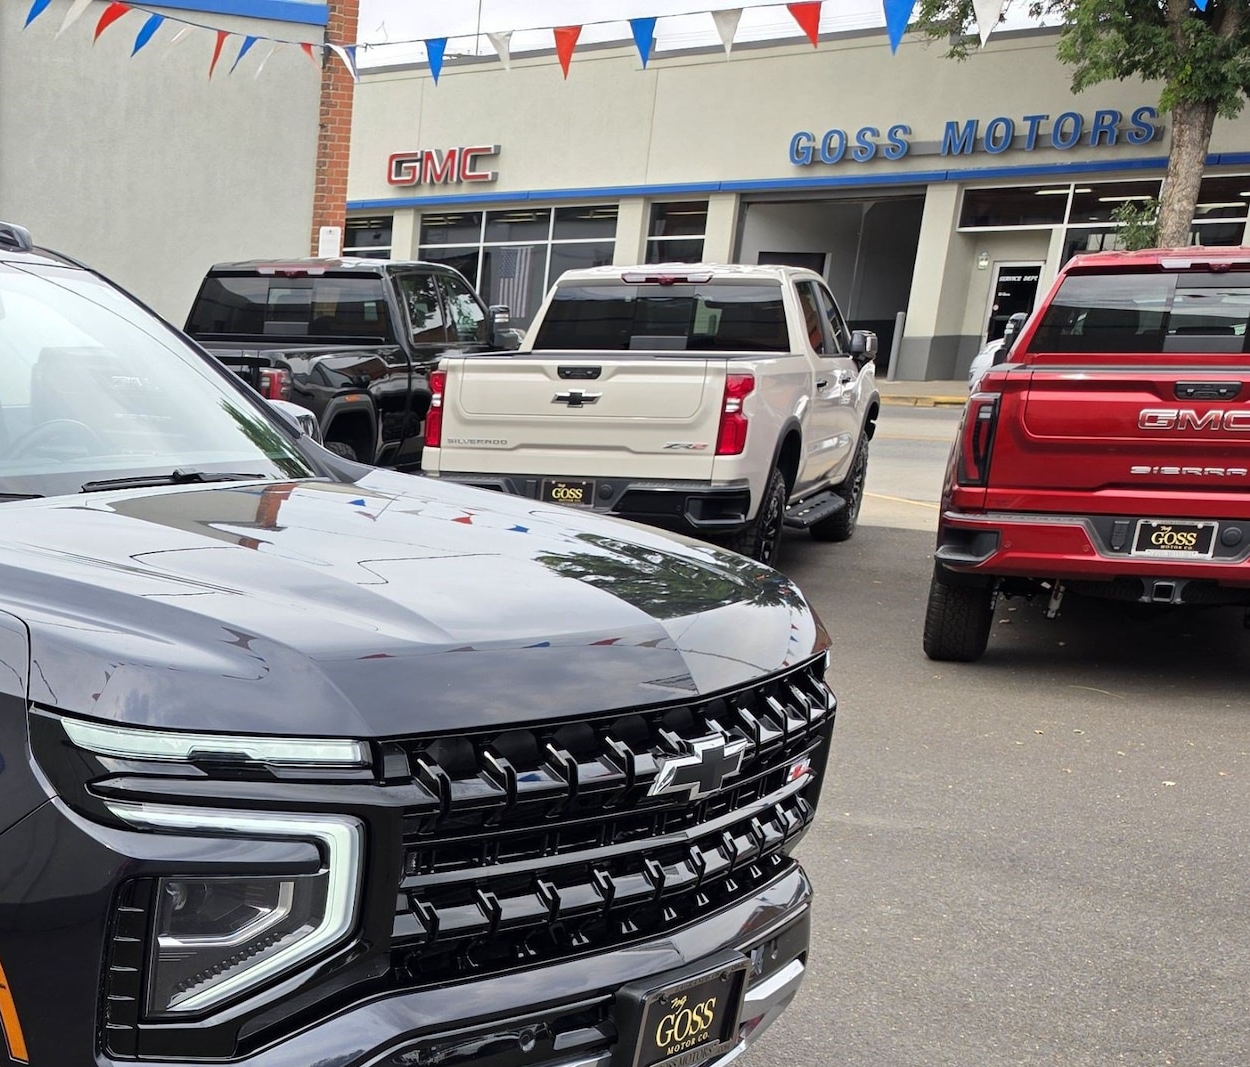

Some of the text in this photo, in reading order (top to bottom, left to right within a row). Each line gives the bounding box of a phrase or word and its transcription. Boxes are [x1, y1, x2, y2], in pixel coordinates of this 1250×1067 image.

[789, 106, 1158, 167] GOSS MOTORS
[387, 145, 501, 187] GMC
[1137, 408, 1250, 431] GMC
[1130, 466, 1248, 476] SIERRA
[552, 487, 583, 499] GOSS
[1151, 531, 1197, 546] GOSS
[655, 997, 717, 1048] GOSS
[666, 1037, 696, 1056] MOTOR
